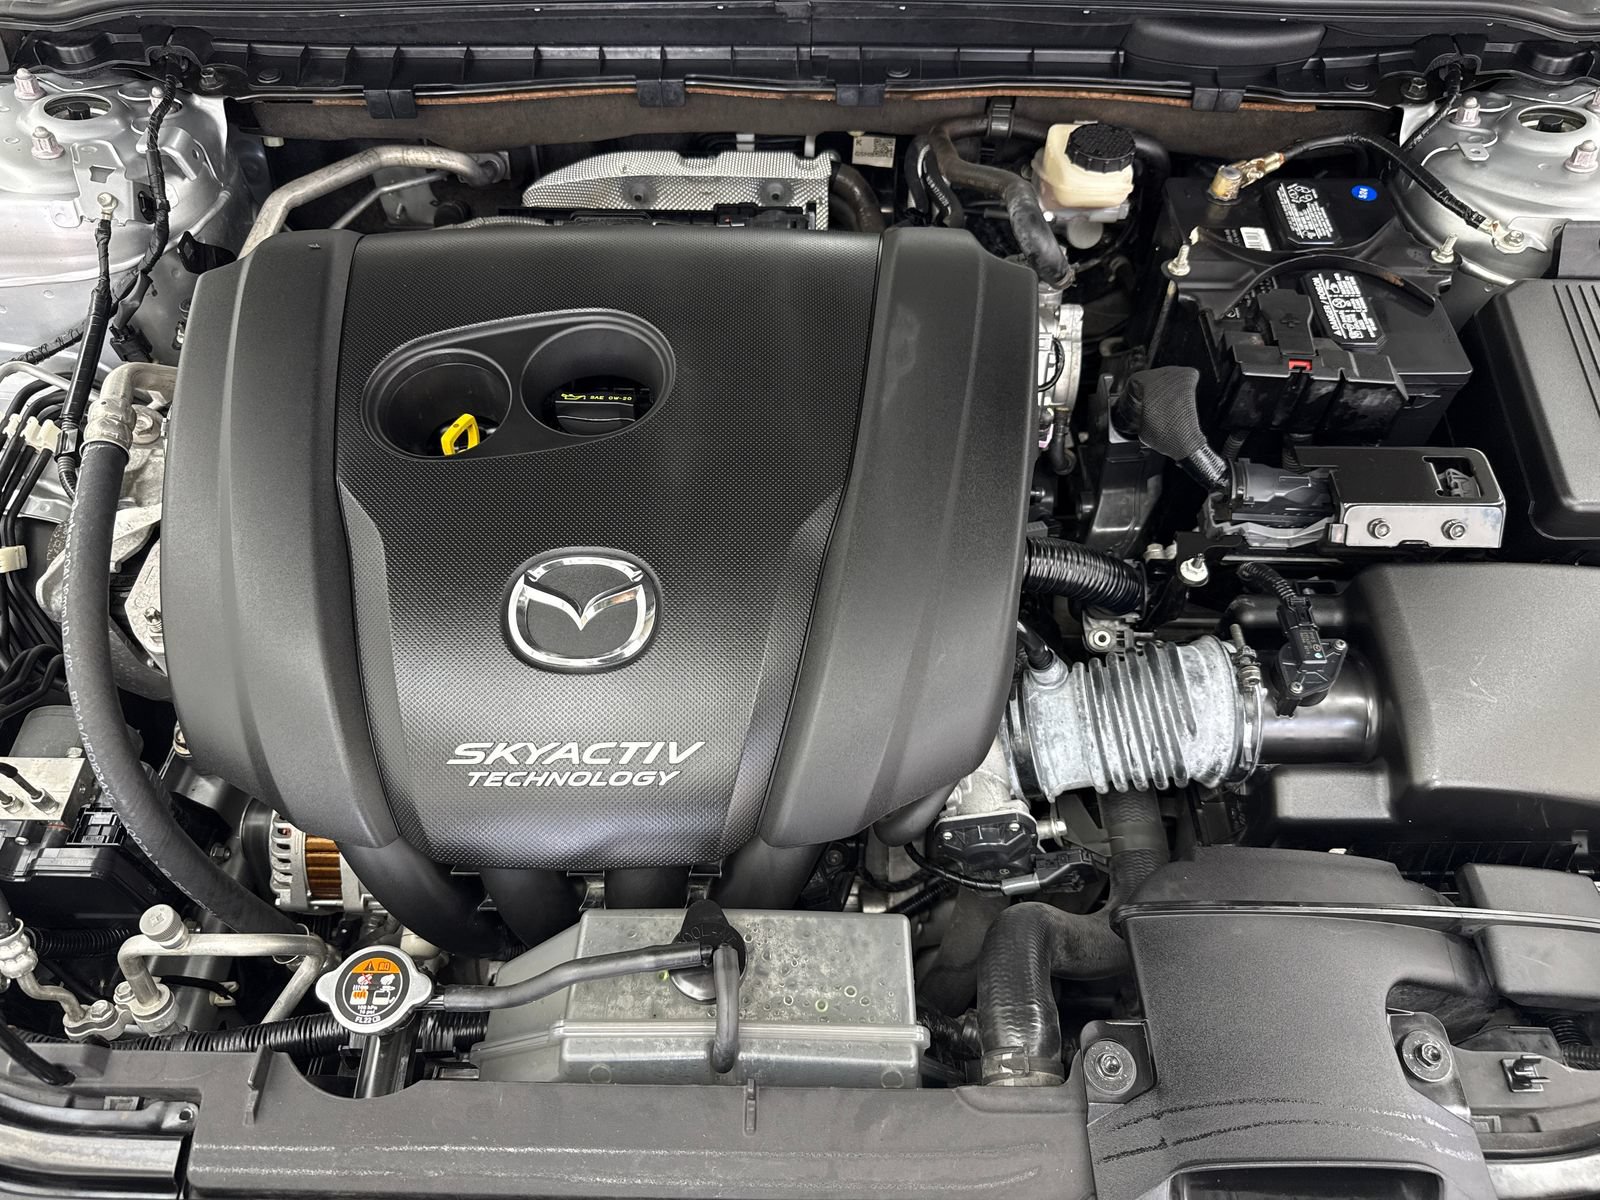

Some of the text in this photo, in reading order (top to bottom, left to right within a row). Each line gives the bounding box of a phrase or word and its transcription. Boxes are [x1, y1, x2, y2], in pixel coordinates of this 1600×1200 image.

[1312, 277, 1327, 301] POISON
[1323, 305, 1340, 331] DANGER
[446, 741, 706, 765] SKYACTIV
[467, 770, 681, 787] TECHNOLOGY
